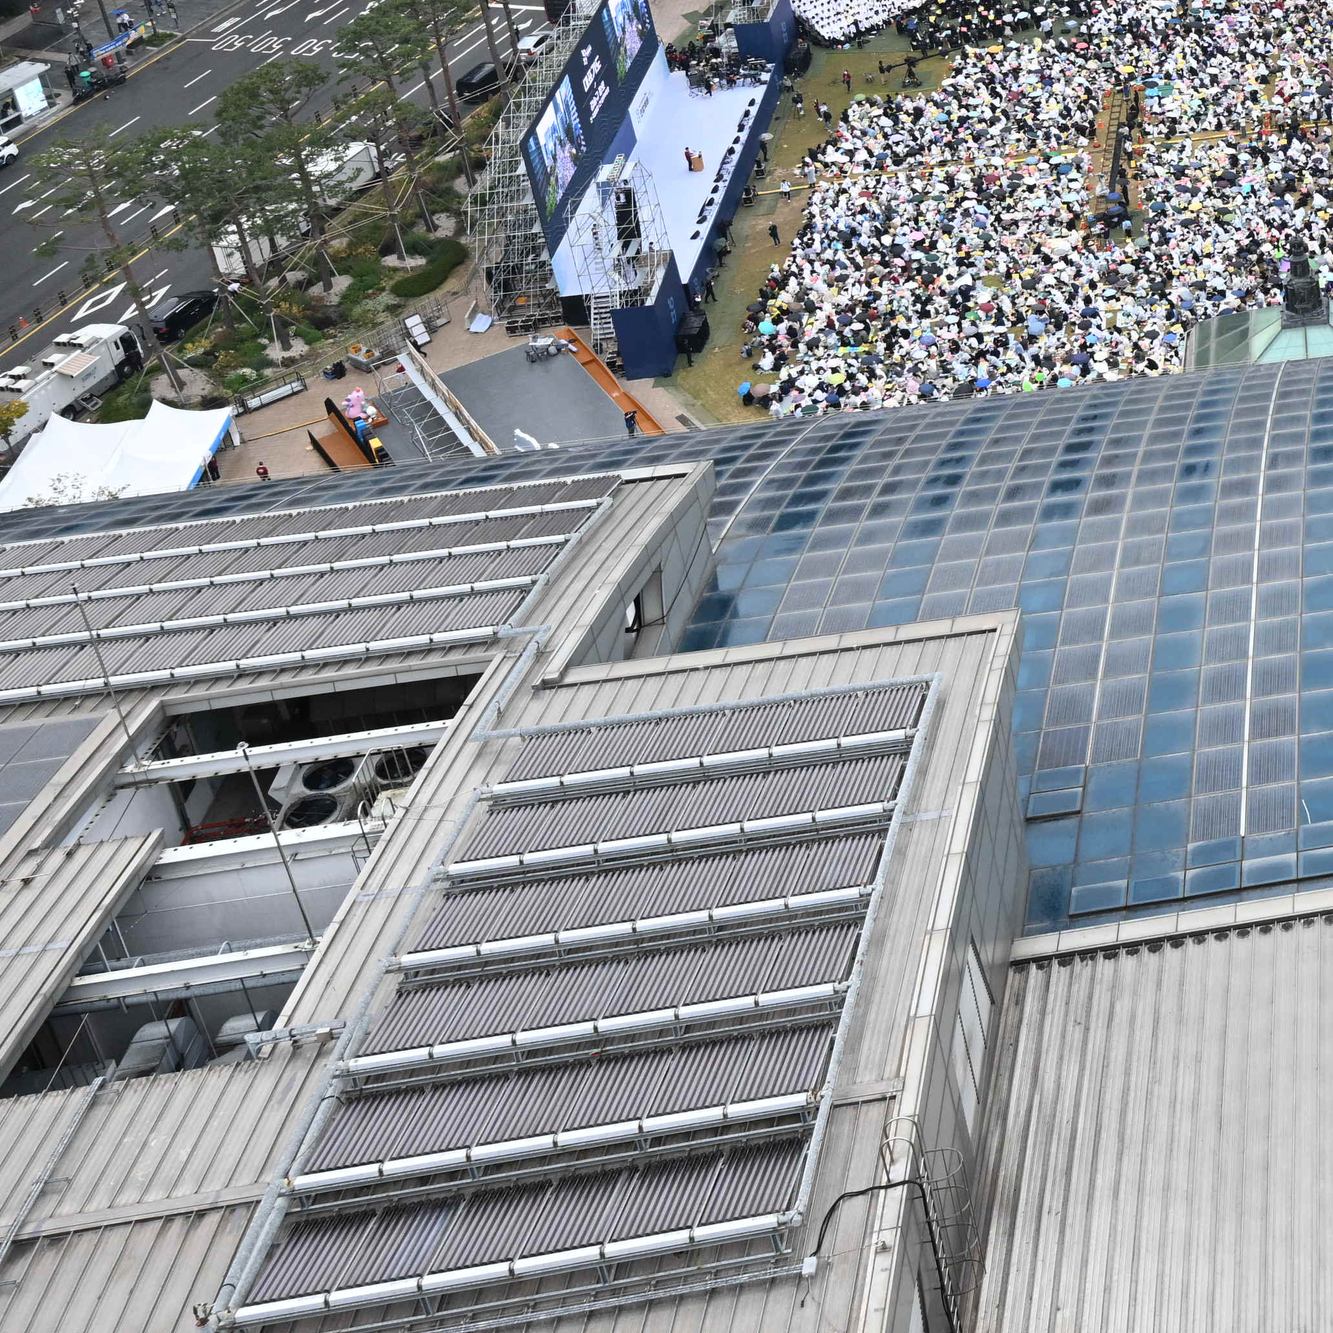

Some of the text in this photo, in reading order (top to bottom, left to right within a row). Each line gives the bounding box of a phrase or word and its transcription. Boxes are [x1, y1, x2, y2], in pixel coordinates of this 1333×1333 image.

[211, 35, 333, 57] 50 50 50
